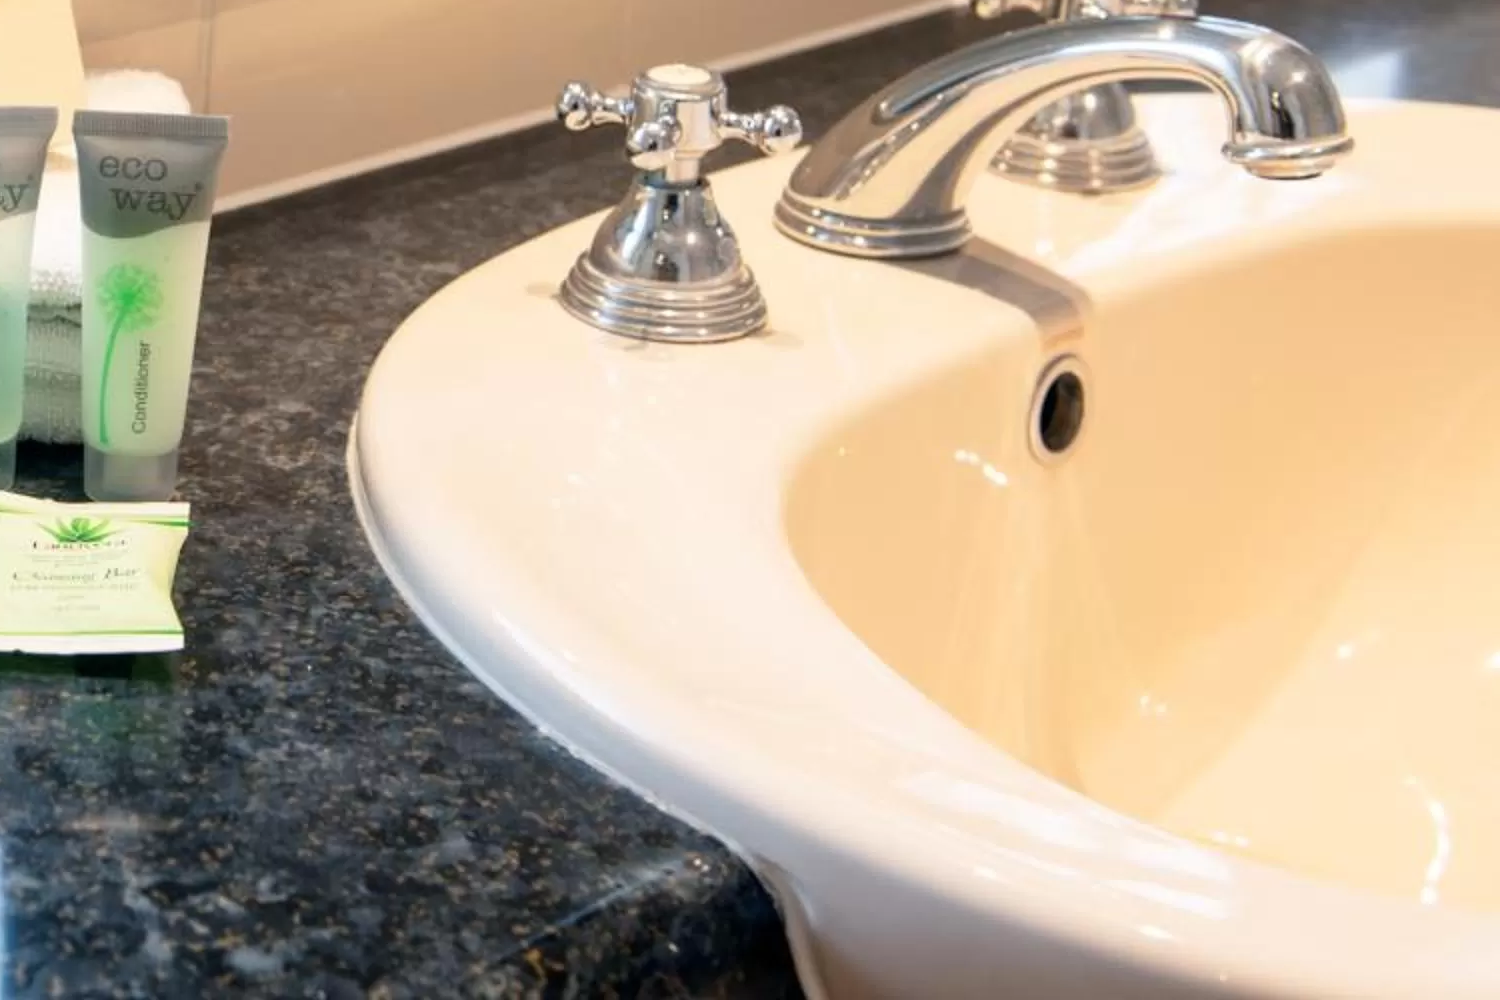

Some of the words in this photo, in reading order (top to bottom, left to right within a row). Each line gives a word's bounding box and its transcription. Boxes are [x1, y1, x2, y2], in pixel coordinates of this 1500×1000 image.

[99, 155, 168, 182] eco
[110, 187, 197, 220] way
[131, 340, 152, 435] Conditioner
